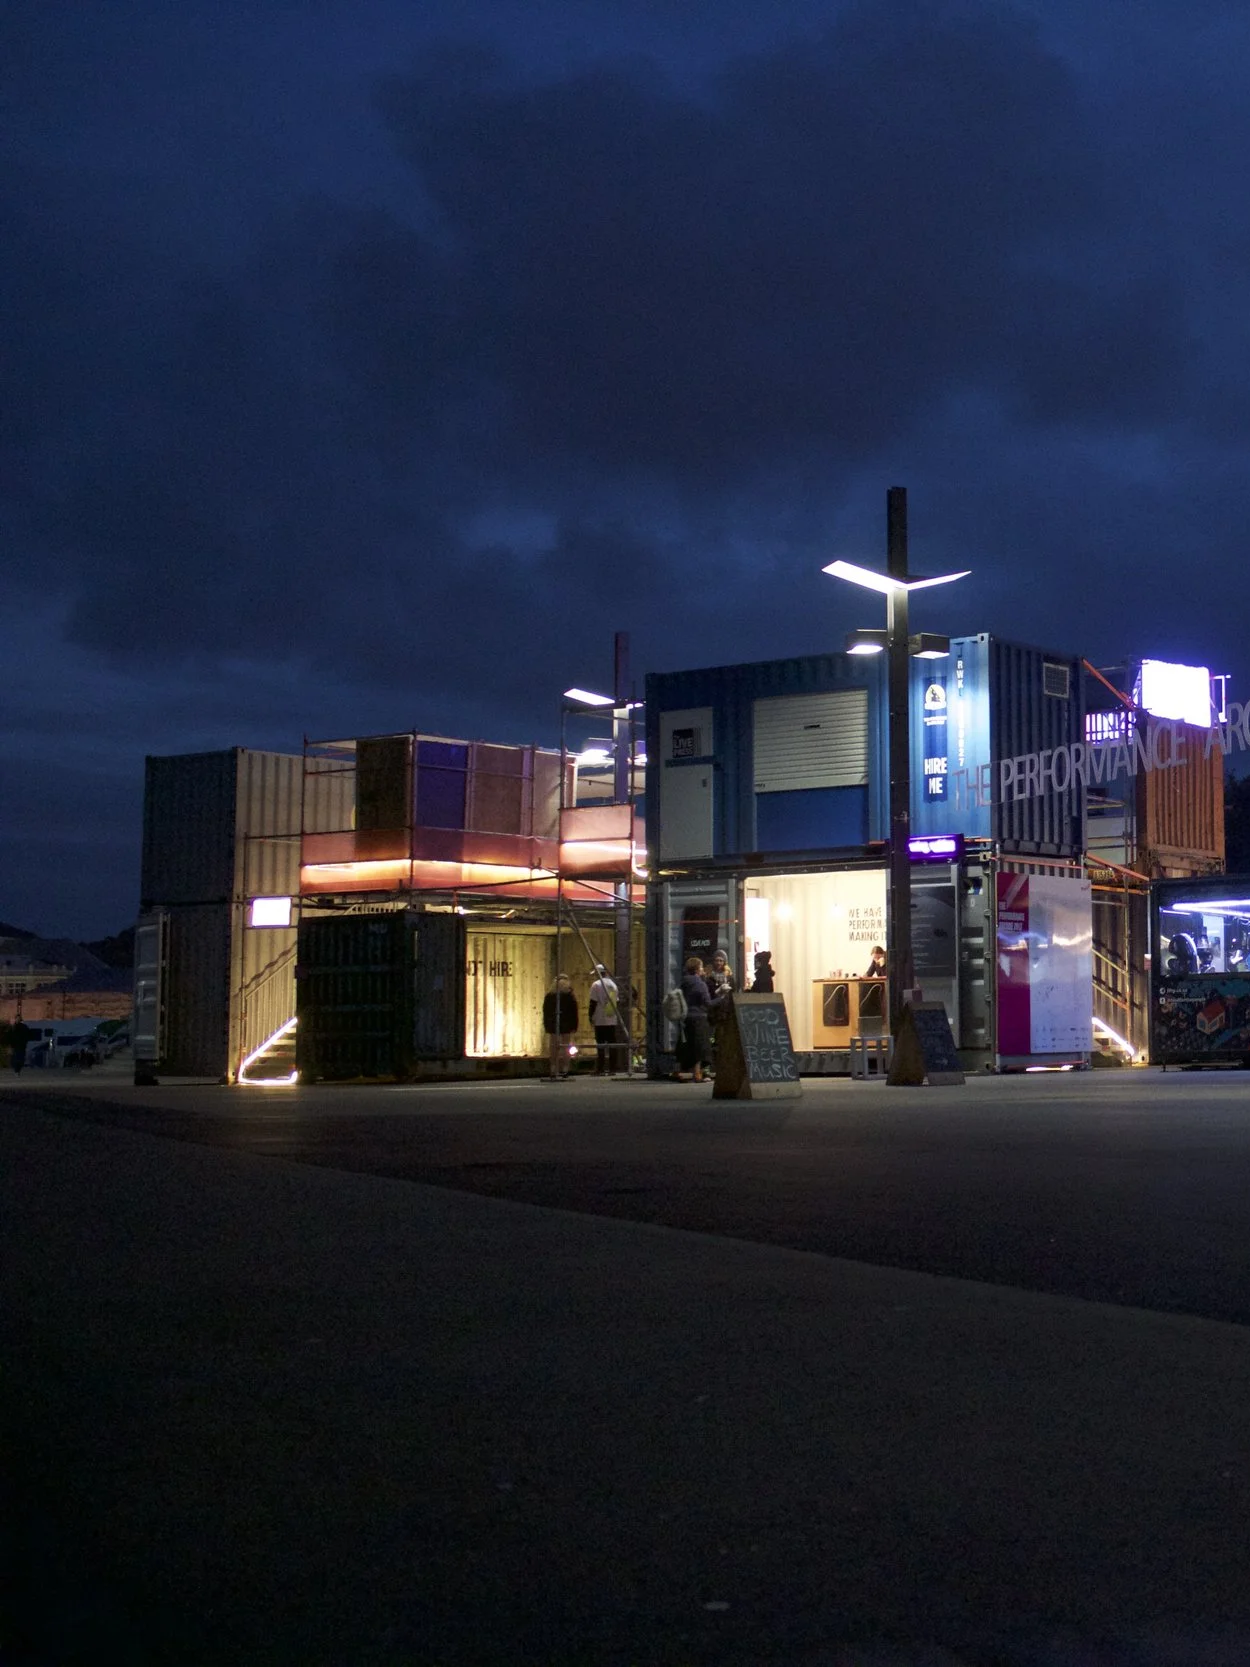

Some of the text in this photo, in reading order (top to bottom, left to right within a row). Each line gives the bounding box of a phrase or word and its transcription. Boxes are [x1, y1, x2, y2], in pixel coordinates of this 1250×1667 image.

[924, 757, 947, 775] HIRE
[952, 763, 992, 811] THE
[1000, 720, 1188, 803] PERFORMANCE
[928, 776, 943, 794] ME
[849, 907, 882, 918] WE HAVE
[849, 919, 886, 930] PERFORM
[849, 931, 878, 941] MAKING
[740, 1007, 779, 1025] FOOD
[743, 1024, 789, 1045] WINE
[744, 1045, 795, 1063] BEER
[749, 1062, 797, 1079] MUSIC
